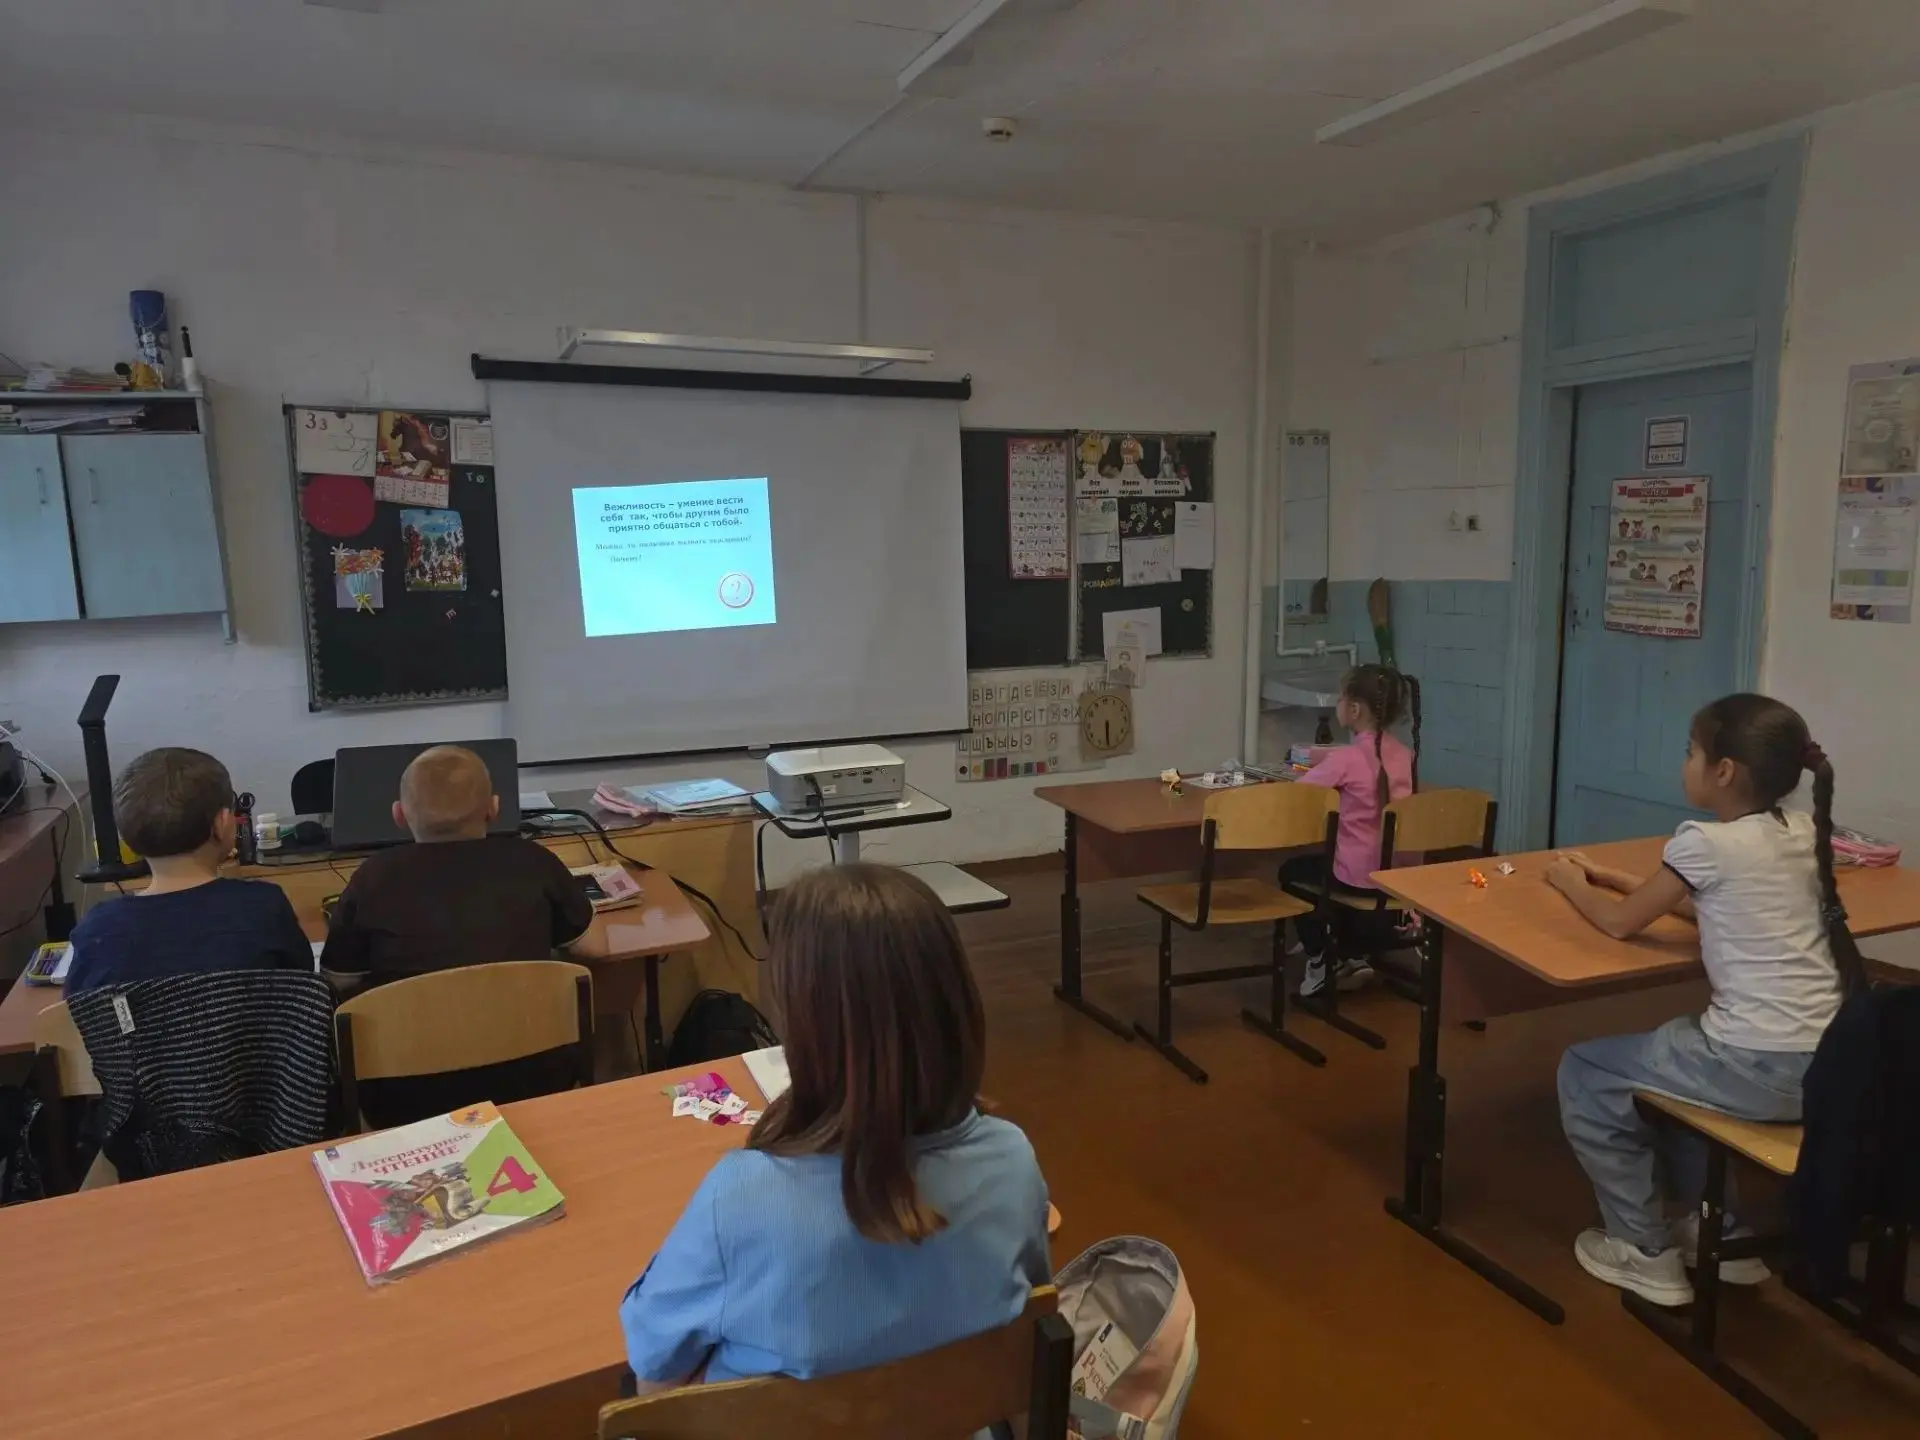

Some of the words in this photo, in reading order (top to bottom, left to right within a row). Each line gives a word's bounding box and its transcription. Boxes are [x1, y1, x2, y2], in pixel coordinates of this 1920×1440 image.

[604, 501, 666, 512] Вежливость
[677, 498, 714, 509] умение
[716, 496, 744, 505] вести
[600, 511, 624, 523] себя
[629, 512, 650, 522] так,
[652, 509, 683, 520] чтобы
[685, 509, 721, 520] другим
[723, 506, 750, 516] было
[608, 522, 651, 534] приятно
[653, 520, 701, 531] общаться
[711, 517, 743, 528] тобой.
[985, 688, 994, 700] В
[972, 714, 980, 727] Н
[1010, 710, 1020, 723] Р
[351, 1132, 472, 1173] Литературное
[373, 1145, 461, 1176] ЧТЕНИЕ
[486, 1155, 539, 1198] 4
